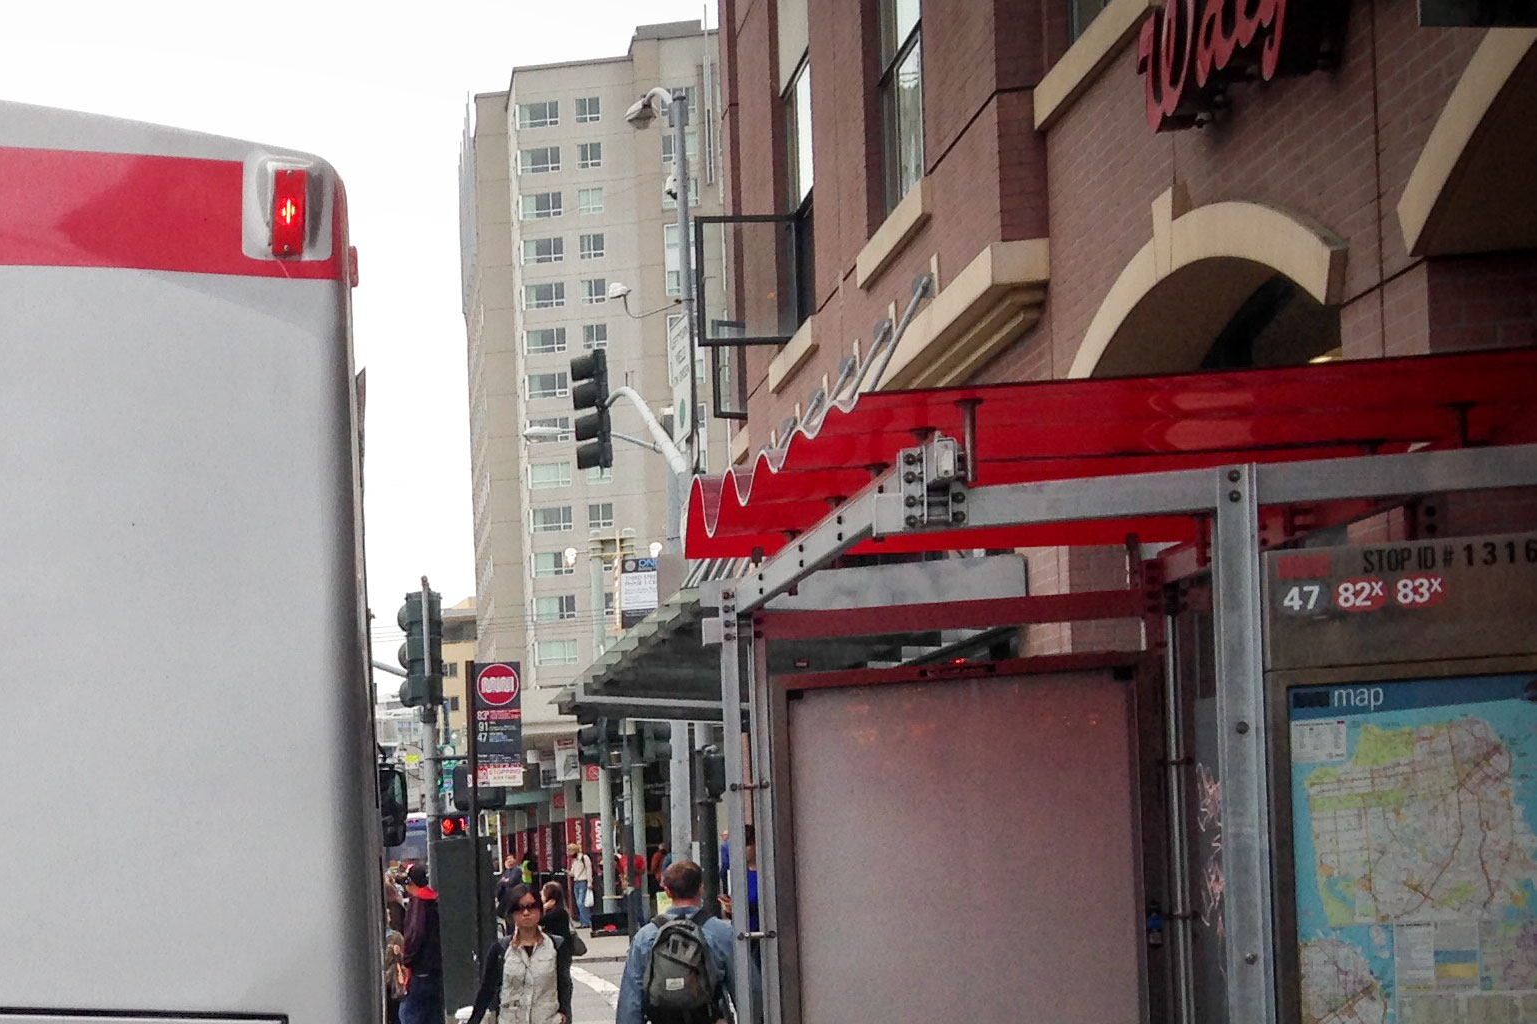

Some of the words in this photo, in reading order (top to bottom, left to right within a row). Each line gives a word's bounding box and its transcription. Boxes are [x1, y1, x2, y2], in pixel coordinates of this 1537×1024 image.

[1364, 548, 1413, 573] STOP
[1417, 545, 1437, 570] ID
[1283, 585, 1320, 611] 47
[1334, 686, 1384, 710] map
[478, 721, 489, 732] 91
